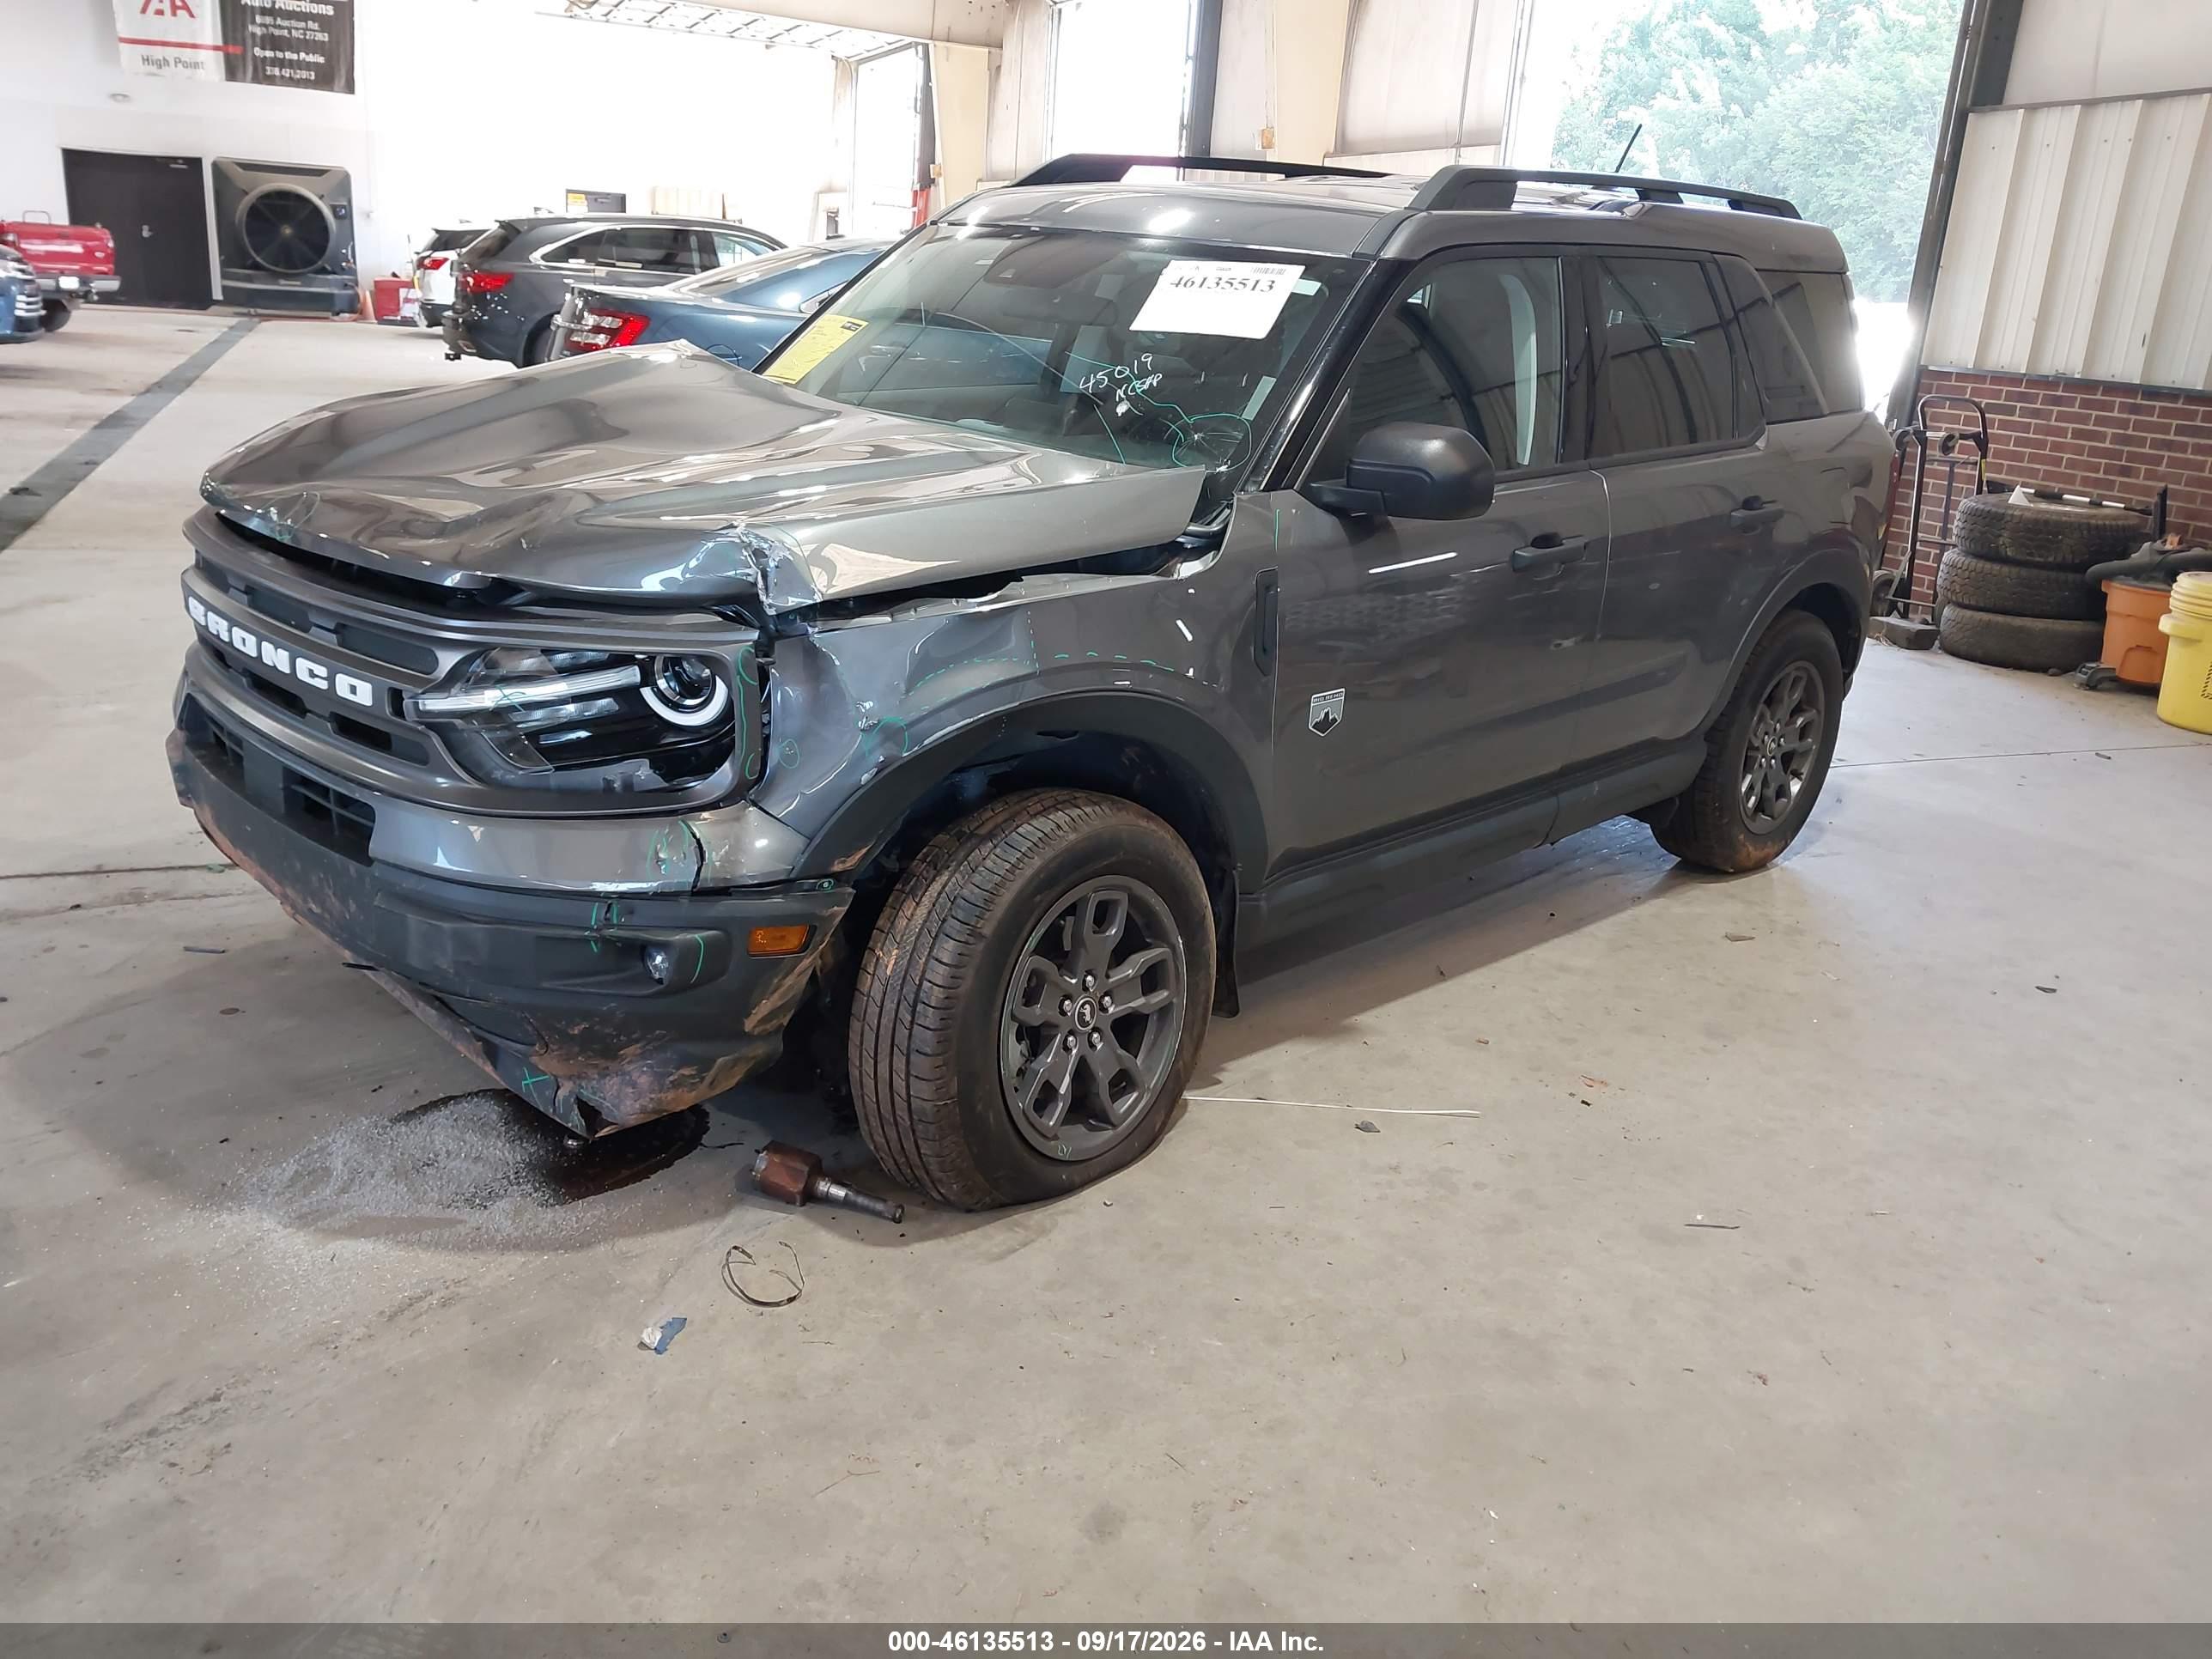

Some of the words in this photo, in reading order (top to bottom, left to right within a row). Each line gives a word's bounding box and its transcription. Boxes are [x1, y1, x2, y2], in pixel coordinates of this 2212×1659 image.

[275, 0, 334, 15] Auctions
[276, 17, 306, 30] Auction
[248, 24, 266, 35] High
[292, 29, 304, 40] NC
[141, 54, 170, 70] High
[173, 57, 205, 70] Point
[253, 46, 274, 58] Open
[276, 49, 283, 58] to
[285, 50, 298, 60] the
[299, 52, 325, 64] Public
[1170, 276, 1276, 293] 46135513
[1079, 353, 1153, 392] 45019
[188, 596, 373, 707] BRONCO
